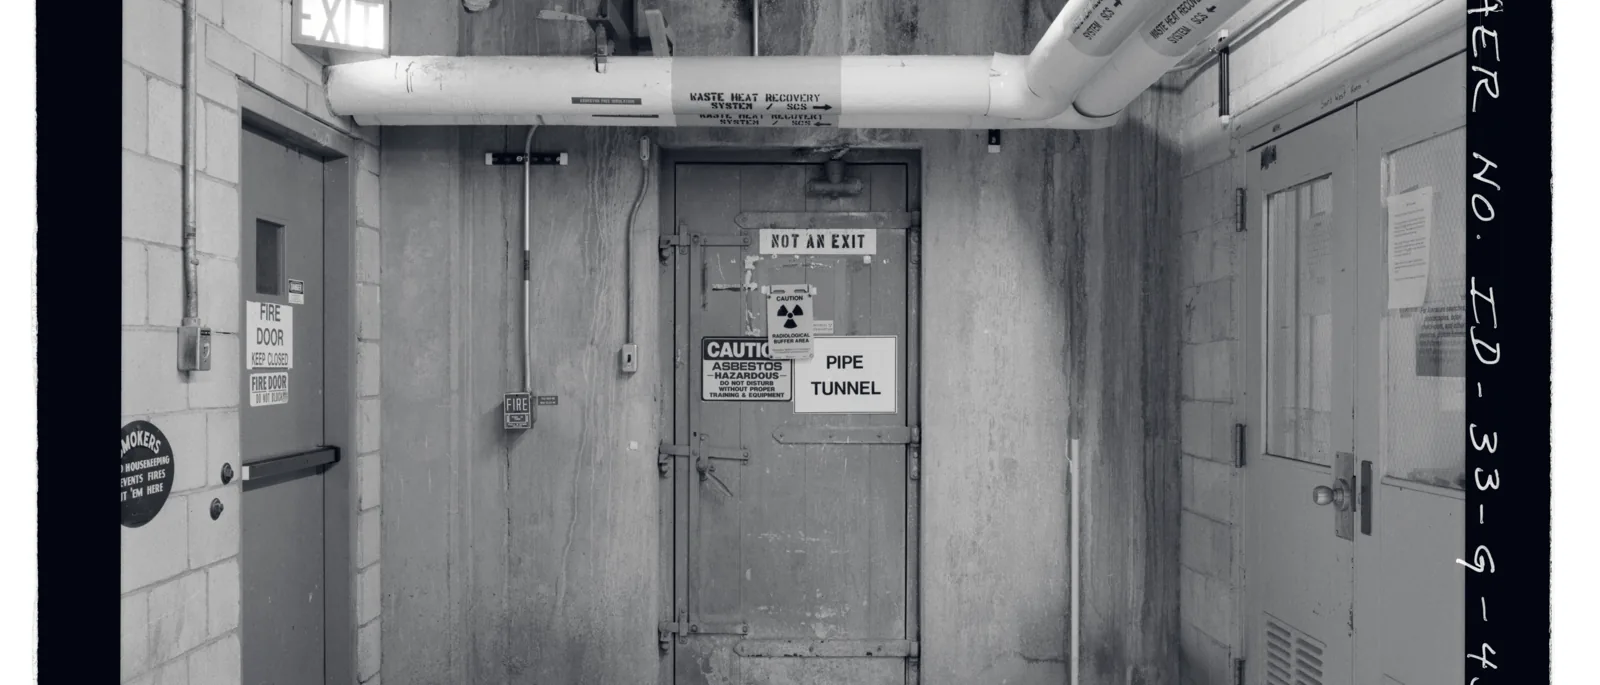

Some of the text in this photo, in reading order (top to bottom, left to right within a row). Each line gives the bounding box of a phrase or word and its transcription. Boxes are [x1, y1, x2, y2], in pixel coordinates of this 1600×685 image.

[1100, 6, 1115, 21] SCS
[299, 0, 381, 47] EXIT
[1149, 21, 1169, 40] WASTE
[1164, 10, 1180, 27] HEAT
[1166, 25, 1191, 44] SYSTEM
[1190, 12, 1209, 25] SCS
[690, 92, 821, 102] WASTE HEAT RECOVERY
[711, 102, 753, 110] SYSTEM
[771, 234, 865, 249] NOT AN EXIT
[260, 303, 281, 322] FIRE
[256, 327, 284, 346] DOOR
[707, 341, 768, 358] CAUTIO
[252, 352, 288, 366] KEEP CLOSED
[712, 361, 783, 371] ASBESTOS
[826, 355, 864, 370] PIPE
[252, 374, 287, 391] FIRE DOOR
[714, 372, 779, 380] HAZARDOUS
[811, 382, 881, 396] TUNNEL
[506, 398, 528, 411] FIRE
[125, 455, 170, 472] HOUSEKEEPING
[147, 468, 166, 481] FIRES
[146, 482, 163, 495] HERE
